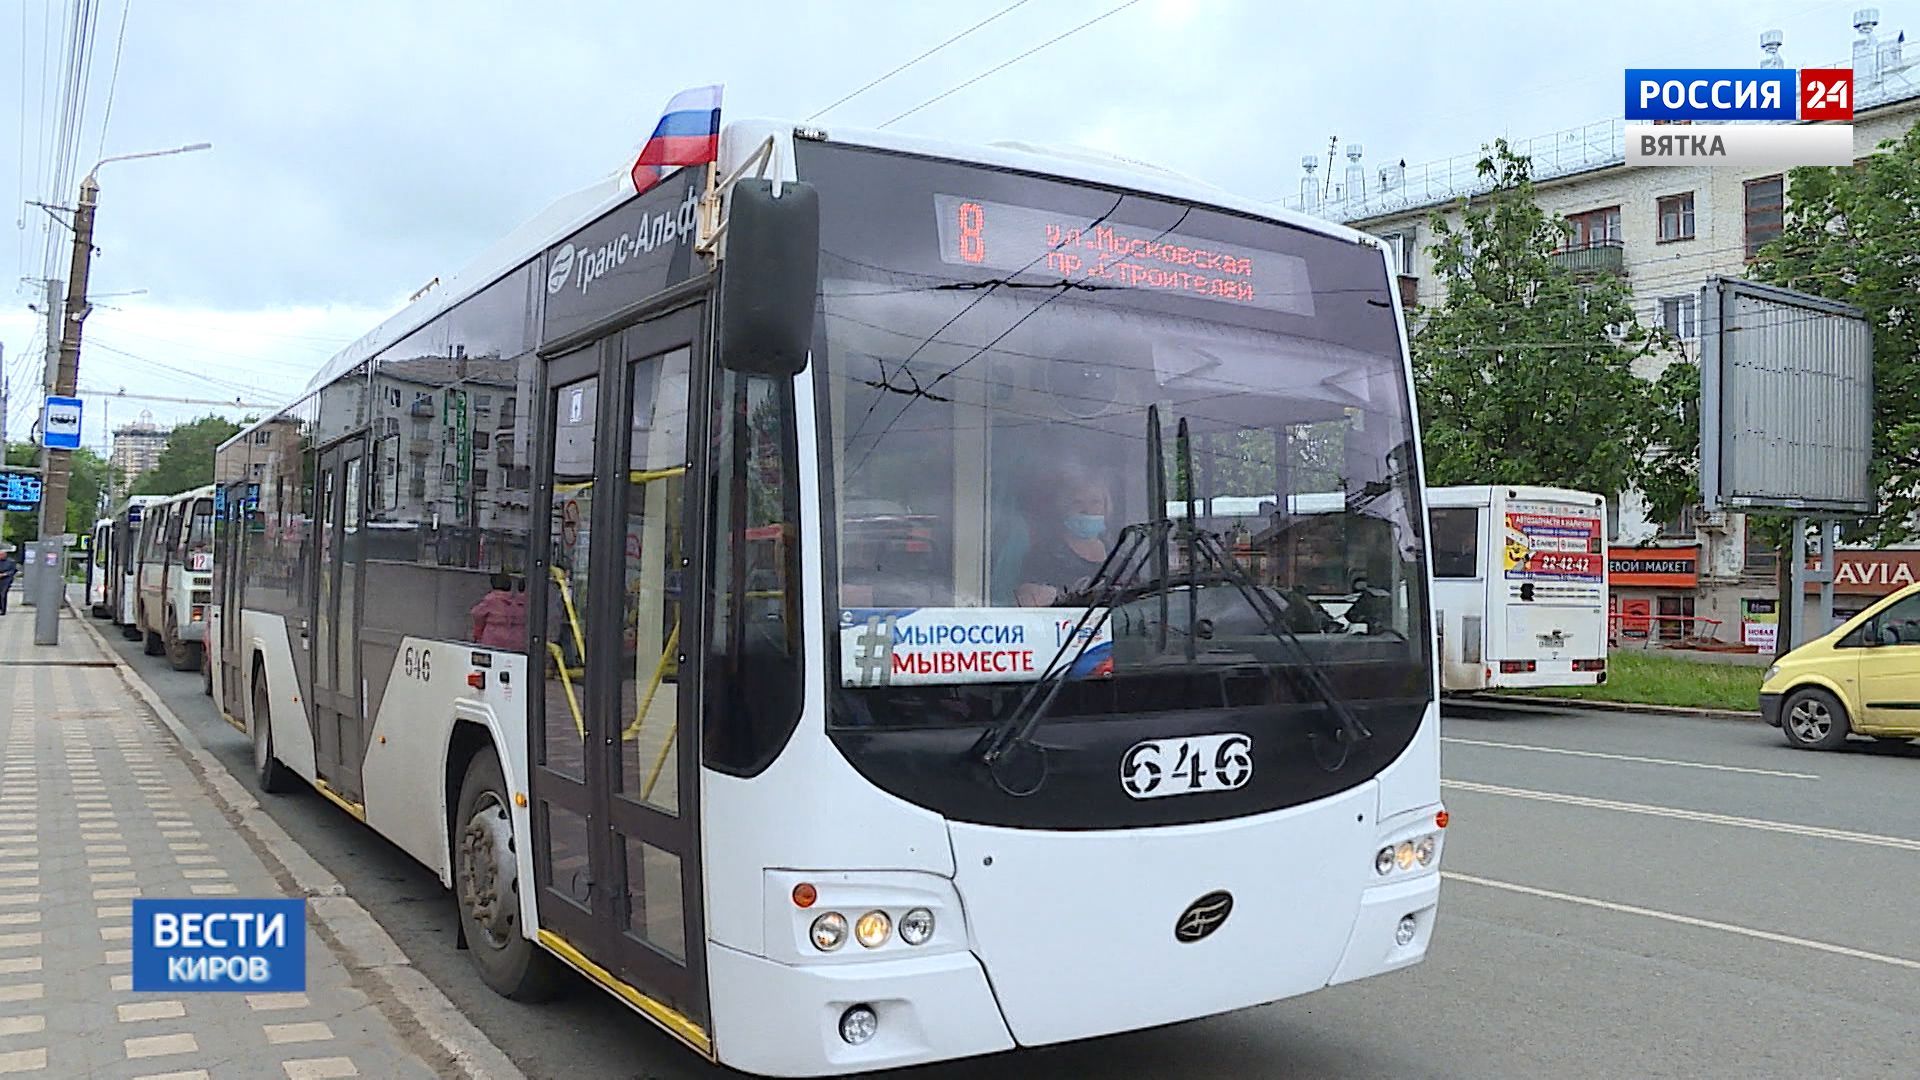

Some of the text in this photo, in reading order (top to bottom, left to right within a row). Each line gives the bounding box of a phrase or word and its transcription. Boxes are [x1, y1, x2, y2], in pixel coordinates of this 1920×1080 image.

[958, 202, 985, 264] 8
[1541, 555, 1590, 573] 22-42-42
[1645, 560, 1687, 572] МАРКЕТ
[405, 647, 431, 682] 646
[891, 650, 1034, 674] МЫВМЕСТЕ
[1123, 737, 1249, 794] 646
